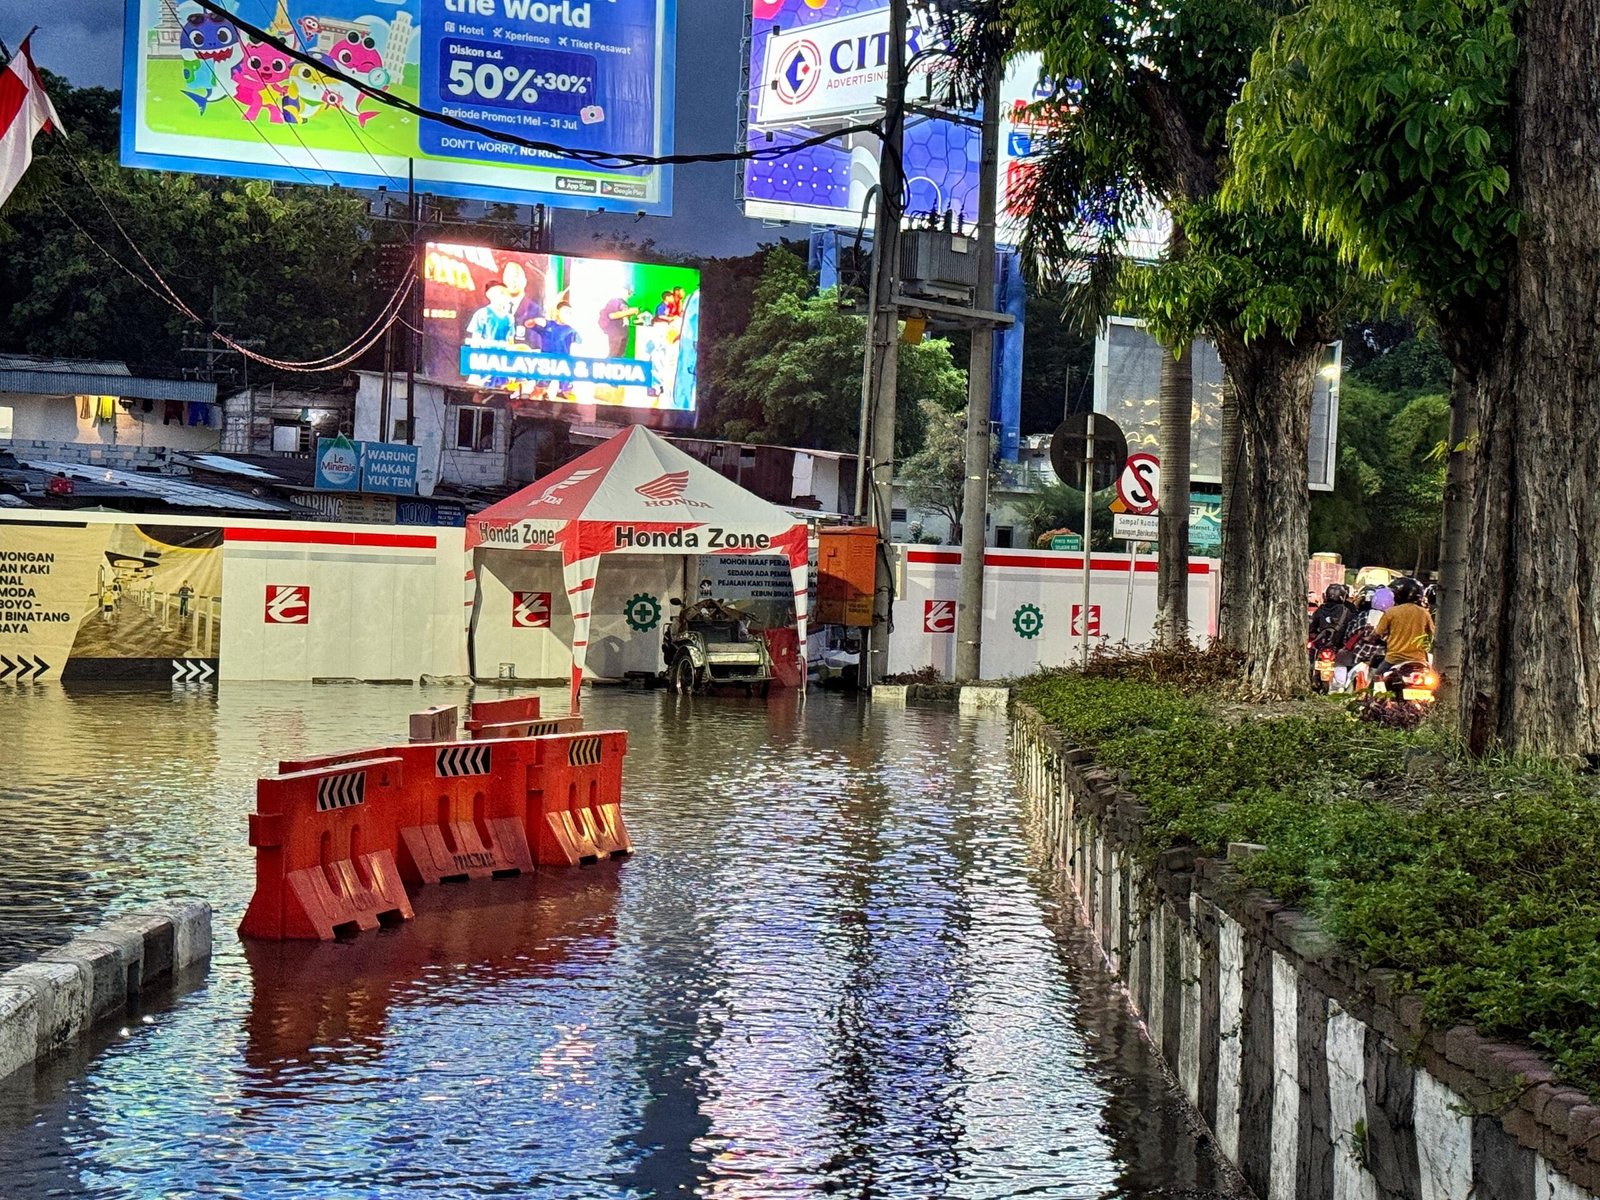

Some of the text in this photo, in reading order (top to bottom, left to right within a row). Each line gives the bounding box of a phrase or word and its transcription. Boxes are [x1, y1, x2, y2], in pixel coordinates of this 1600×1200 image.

[458, 24, 485, 36] Hotel
[504, 30, 550, 44] Xperience
[449, 44, 504, 60] Diskon s.d.
[570, 38, 632, 55] Tiket Pesawat
[447, 59, 539, 104] 50%
[441, 106, 481, 120] Periode
[481, 111, 517, 125] Promo:
[517, 115, 523, 125] 1
[523, 115, 541, 127] Mei
[550, 118, 561, 129] 31
[563, 120, 578, 131] Jul
[440, 137, 475, 150] DON'T
[476, 141, 519, 155] WORRY,
[520, 146, 537, 157] NO
[469, 352, 646, 382] MALAYSIA & INDIA
[333, 453, 344, 464] Le
[367, 449, 416, 463] WARUNG
[321, 461, 356, 473] Minerale
[371, 462, 410, 475] MAKAN
[367, 475, 389, 486] YUK
[391, 476, 412, 488] TEN
[642, 498, 711, 510] HONDA
[400, 502, 431, 524] TOKO
[479, 522, 555, 545] Honda Zone
[615, 525, 771, 550] Honda Zone
[719, 558, 747, 566] MOHON
[748, 558, 769, 566] MAAF
[20, 564, 50, 575] KAKI
[727, 569, 754, 577] SEDANG
[0, 588, 36, 598] MODA
[5, 611, 71, 622] BINATANG
[0, 624, 29, 634] AYA
